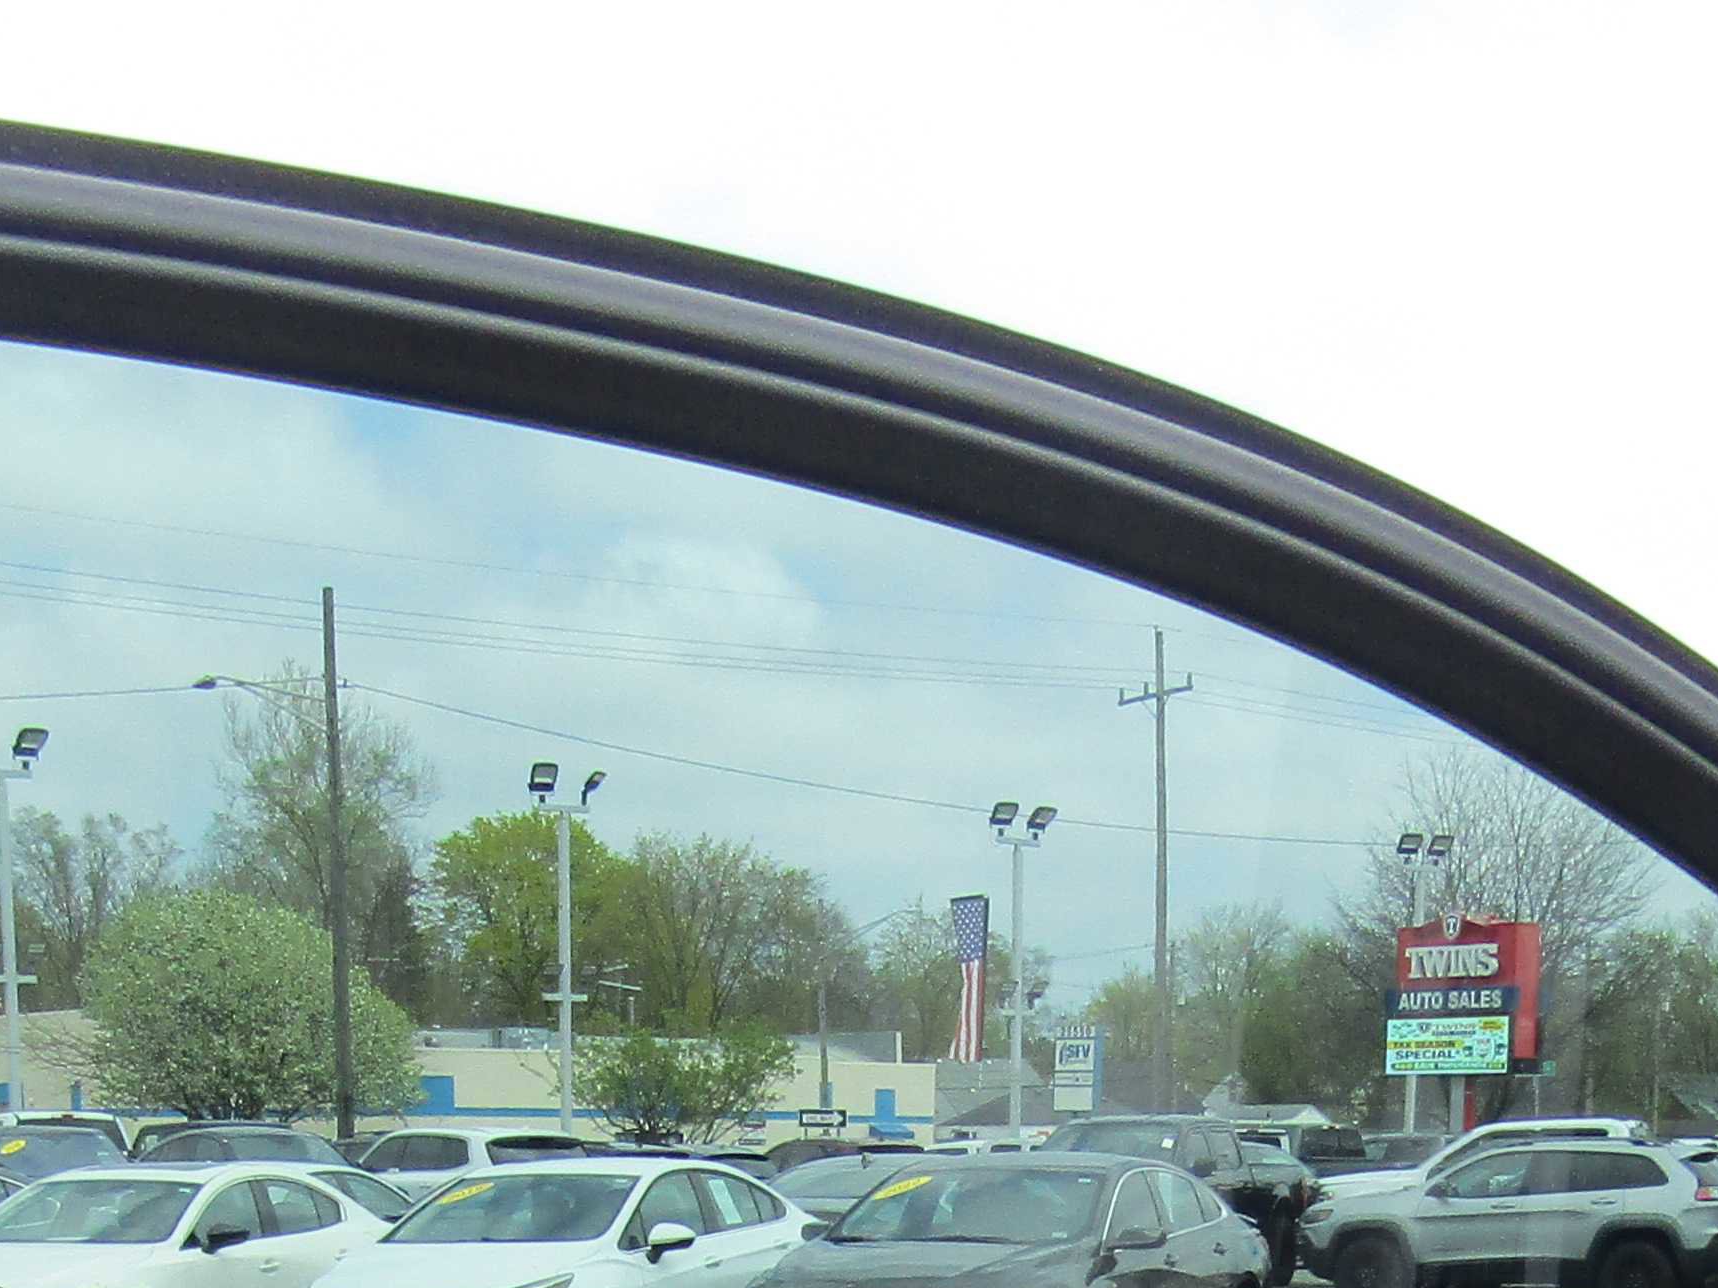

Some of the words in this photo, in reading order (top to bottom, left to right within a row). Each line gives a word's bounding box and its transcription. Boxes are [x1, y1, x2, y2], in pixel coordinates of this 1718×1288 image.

[1405, 943, 1500, 979] TWINS
[1398, 991, 1444, 1010] AUTO
[1448, 988, 1502, 1009] SALES
